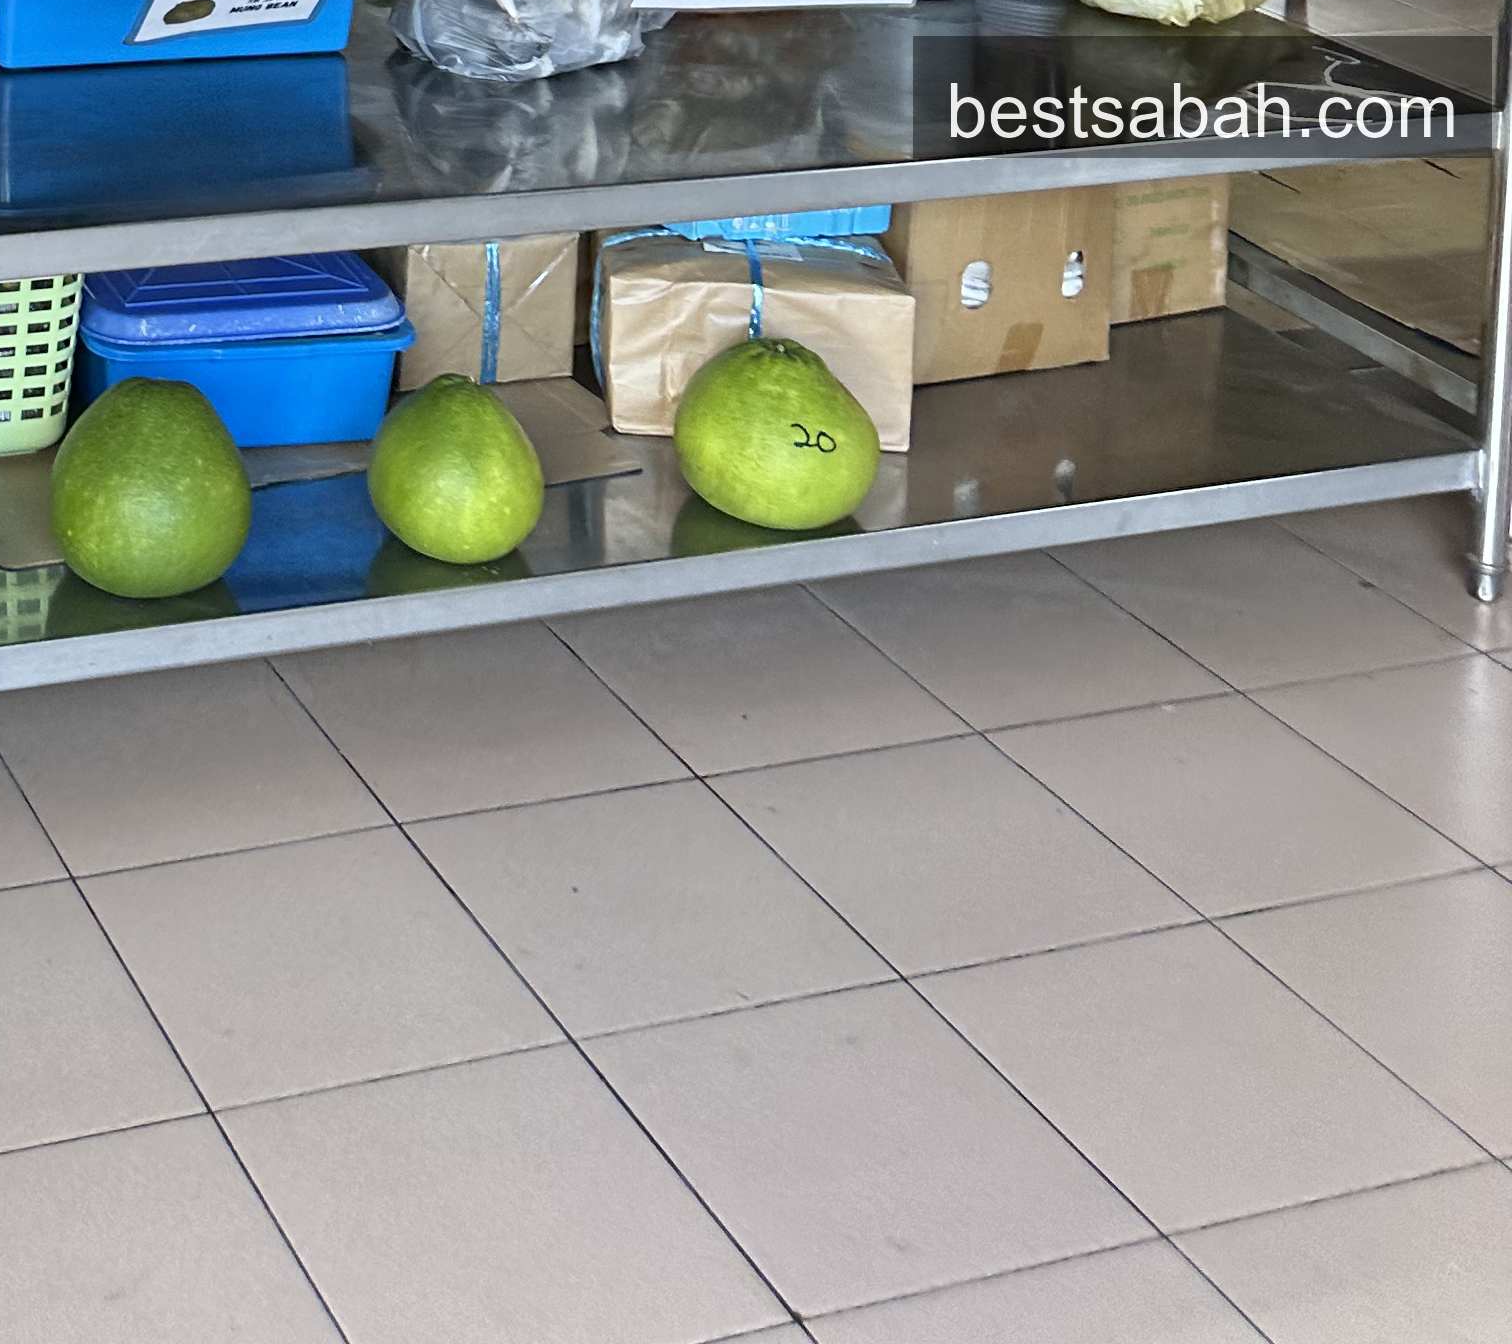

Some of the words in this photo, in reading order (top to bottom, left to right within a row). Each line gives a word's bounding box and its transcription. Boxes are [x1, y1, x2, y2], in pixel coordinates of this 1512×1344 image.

[228, 4, 262, 14] MUNG
[265, 0, 299, 11] BEAN
[790, 423, 838, 453] 20
